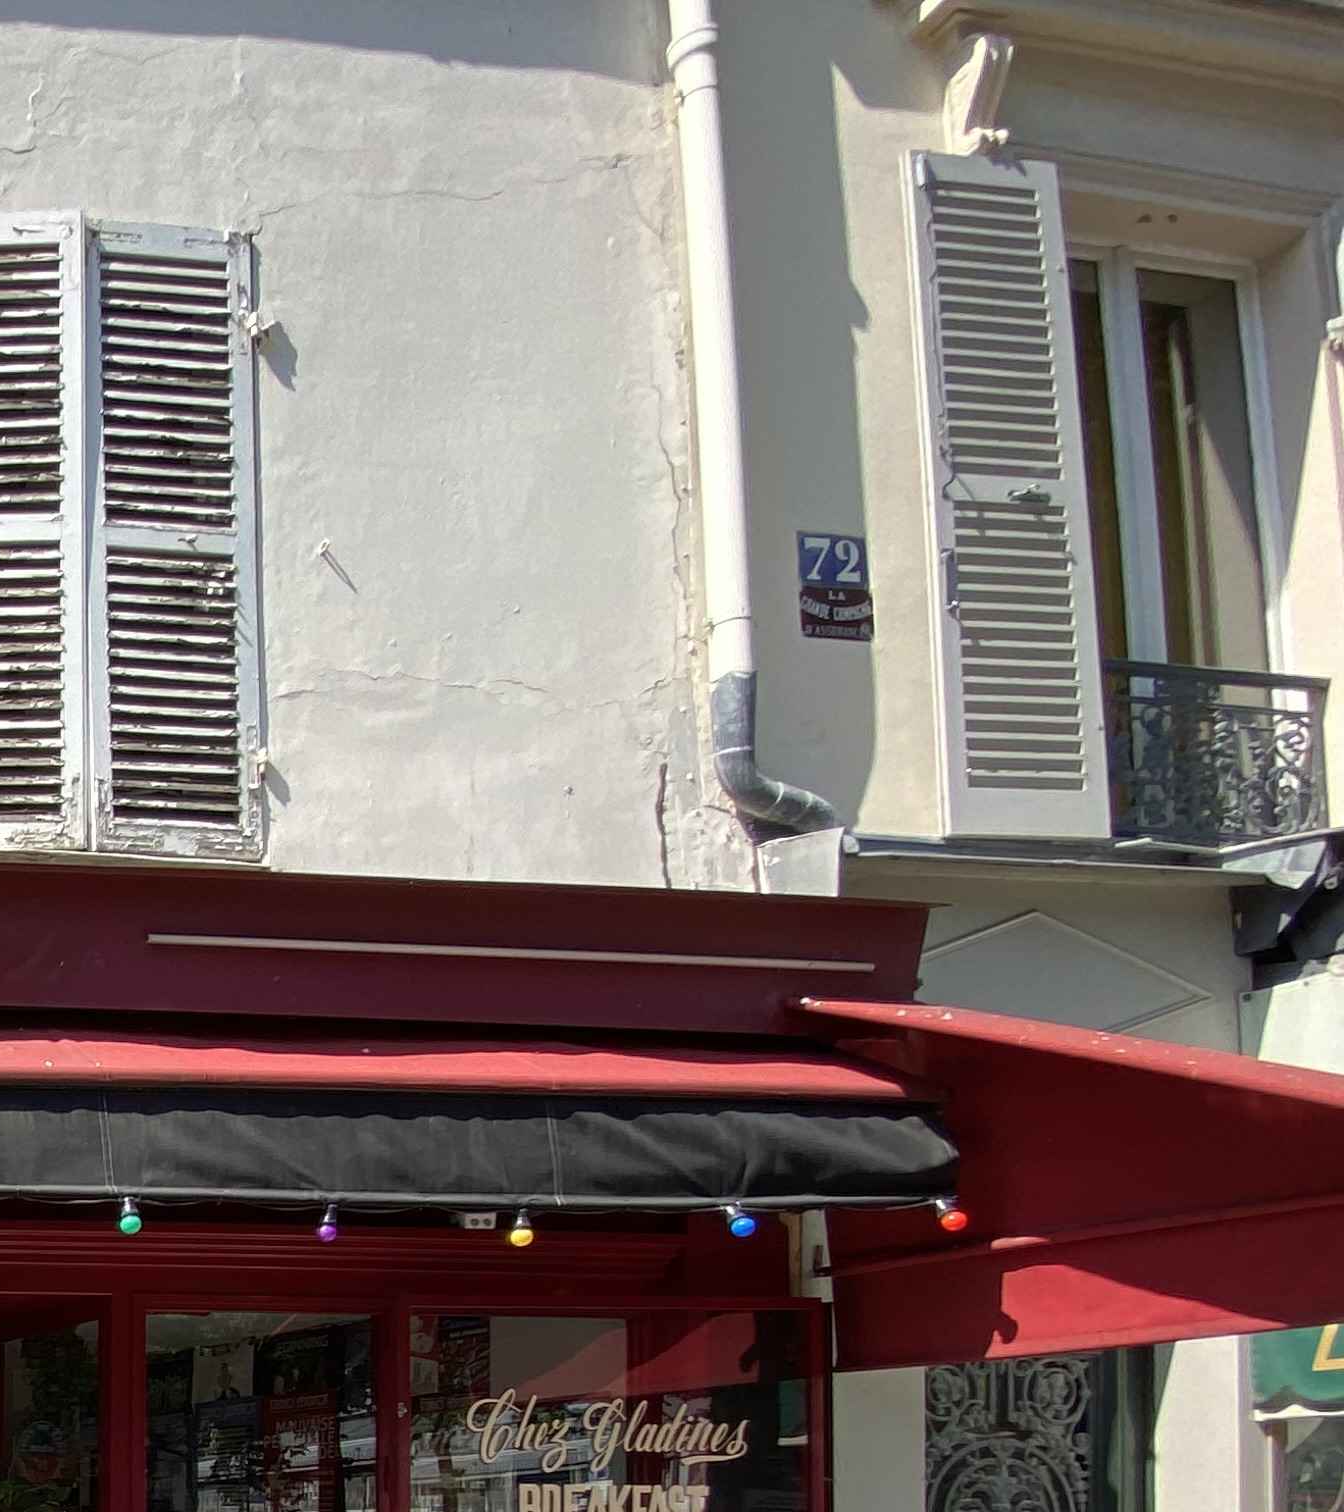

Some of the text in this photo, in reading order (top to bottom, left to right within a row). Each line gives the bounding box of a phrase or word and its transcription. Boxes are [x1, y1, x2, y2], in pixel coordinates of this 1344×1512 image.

[804, 537, 861, 582] 72
[467, 1389, 751, 1473] Chez Gladines
